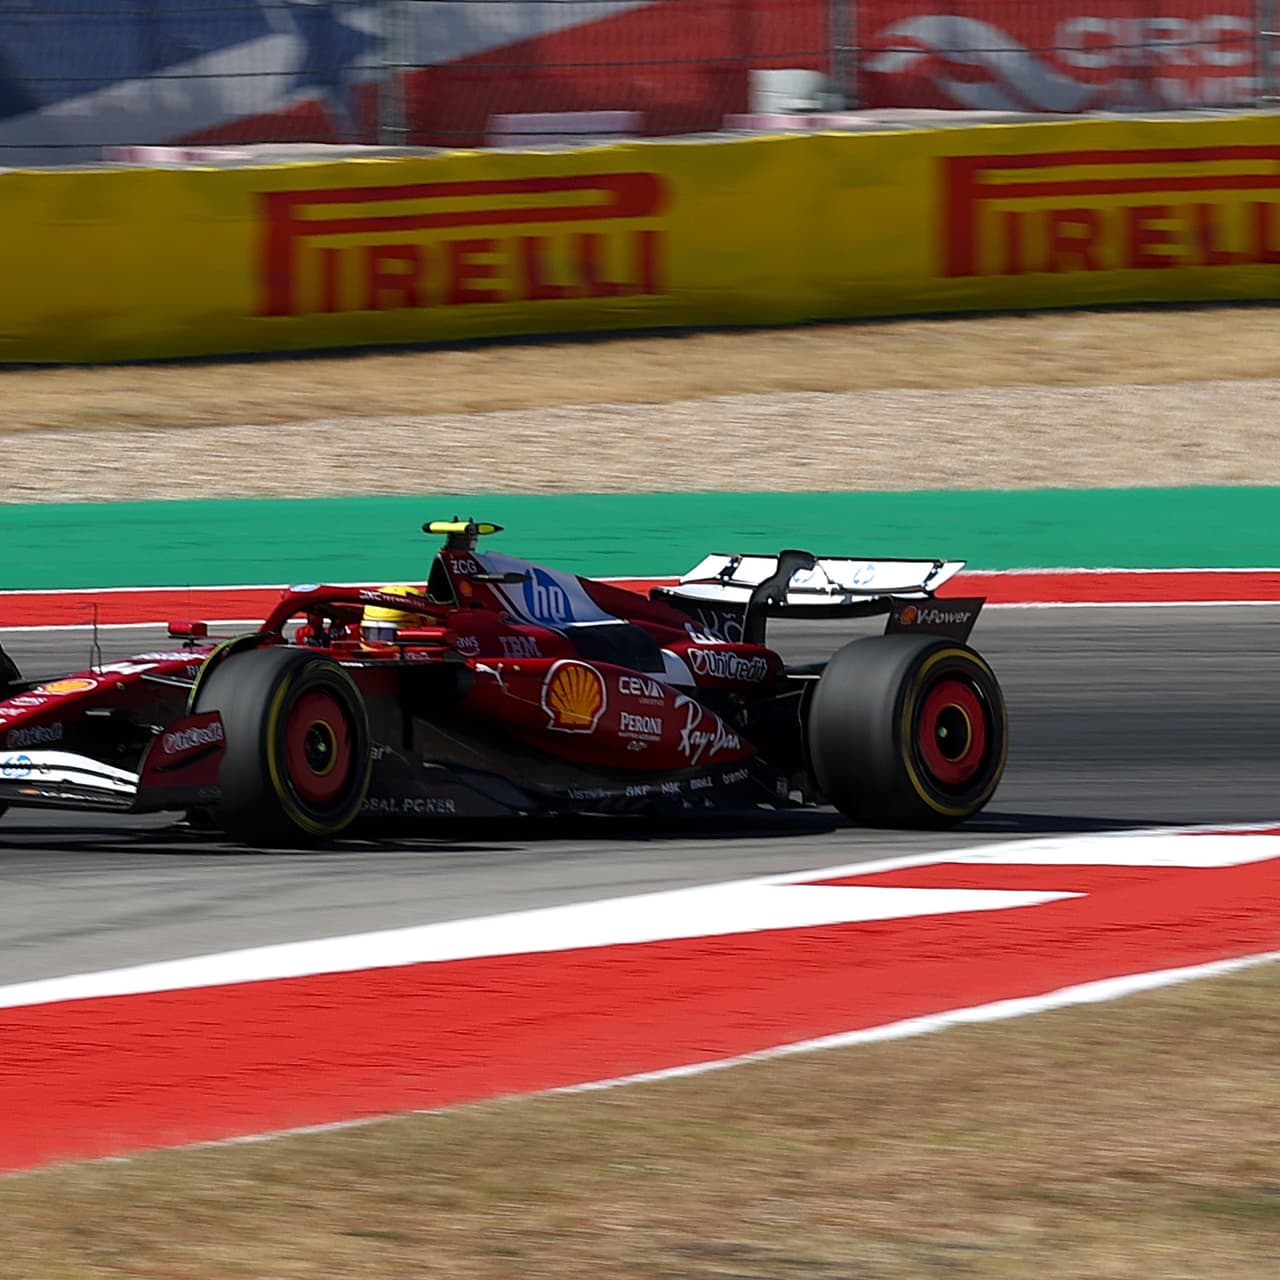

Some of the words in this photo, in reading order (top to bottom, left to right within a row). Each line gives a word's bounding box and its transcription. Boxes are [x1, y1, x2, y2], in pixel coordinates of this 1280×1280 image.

[252, 171, 674, 317] PIRELLI
[529, 569, 569, 623] hp
[499, 636, 542, 658] IBM
[706, 649, 768, 681] UniCredit
[620, 711, 663, 734] PERONI
